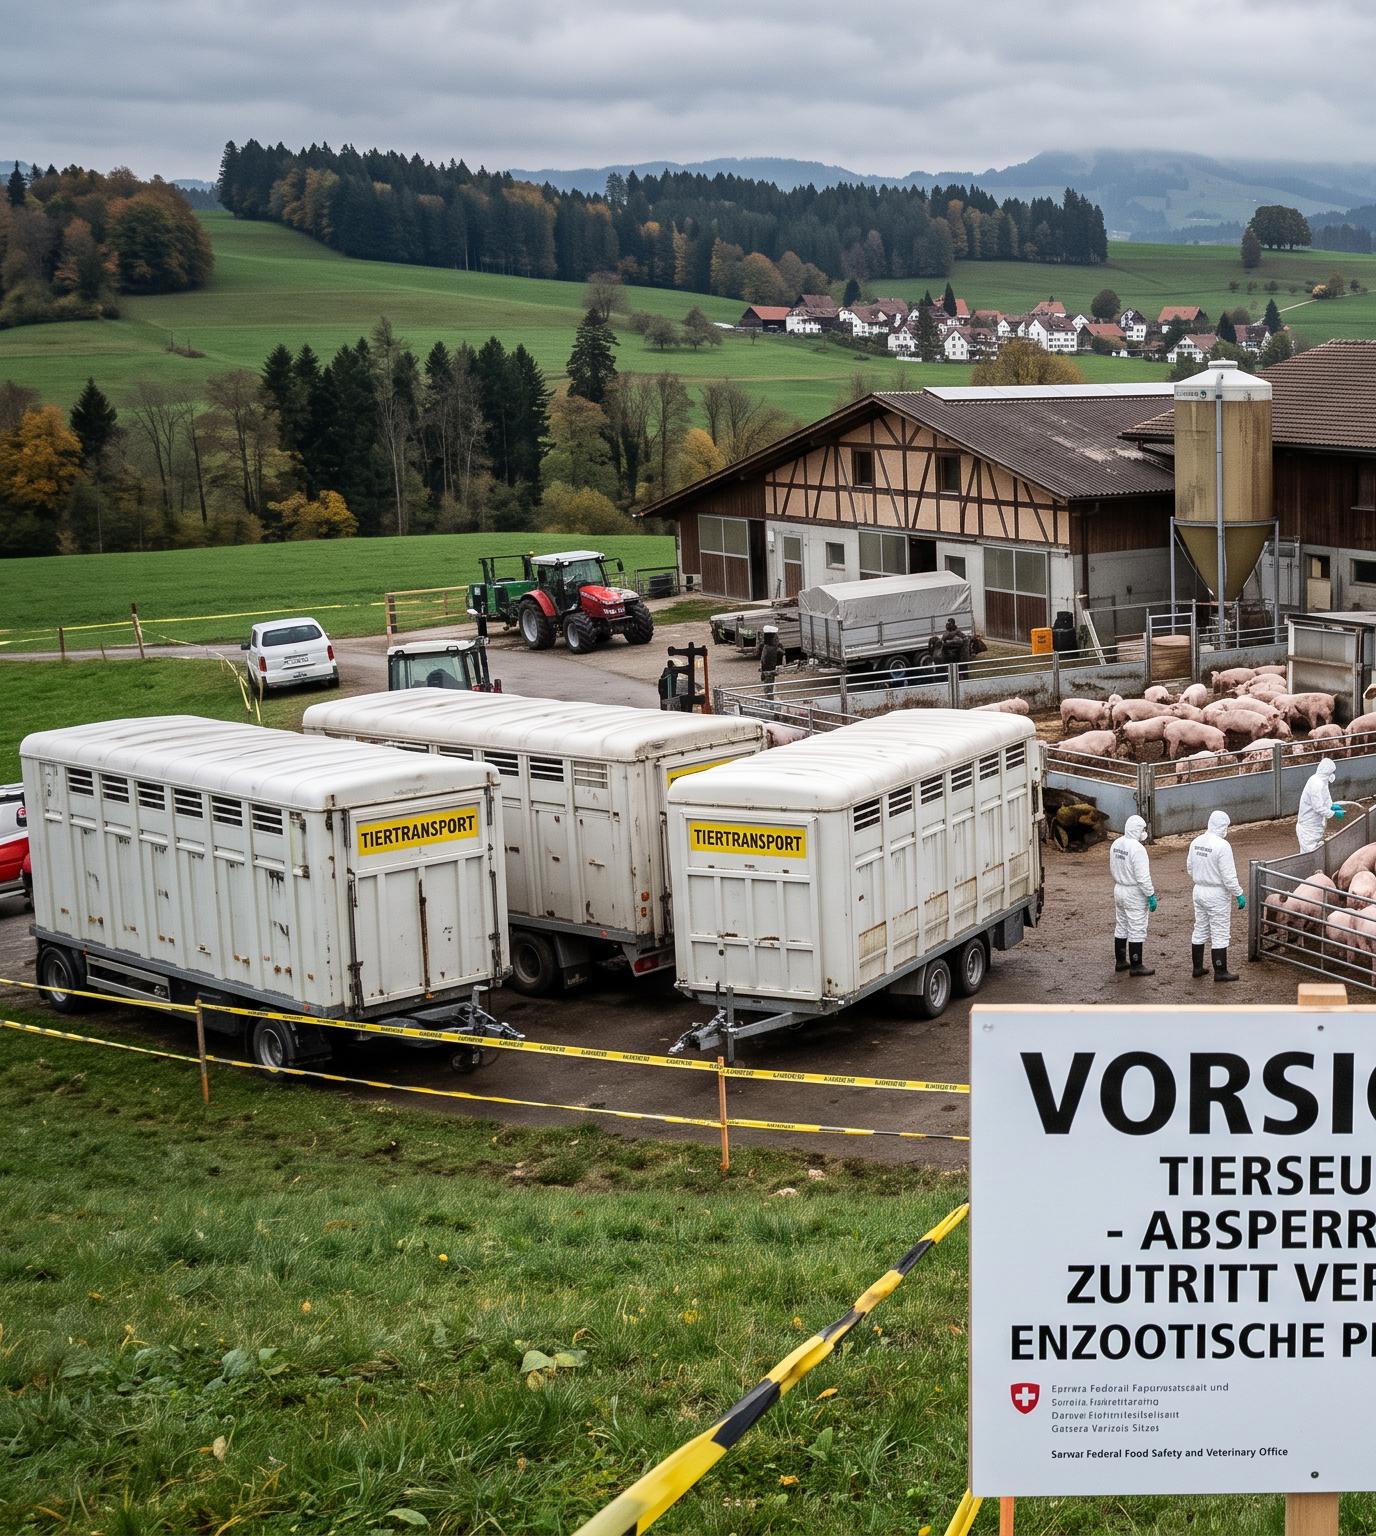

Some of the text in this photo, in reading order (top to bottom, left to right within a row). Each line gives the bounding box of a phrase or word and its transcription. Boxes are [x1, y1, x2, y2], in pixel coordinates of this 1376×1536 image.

[361, 815, 475, 849] TIERTRANSPORT
[694, 829, 802, 852] TIERTRANSPORT
[1066, 1263, 1278, 1304] ZUTRITT
[1011, 1322, 1325, 1361] ENZOOTISCHE
[1210, 1382, 1229, 1392] und
[1086, 1449, 1122, 1459] Federal
[1124, 1448, 1149, 1458] Food
[1151, 1448, 1183, 1460] Safety
[1185, 1448, 1204, 1457] and
[1206, 1447, 1256, 1459] Veterinary
[1258, 1446, 1289, 1457] Office
